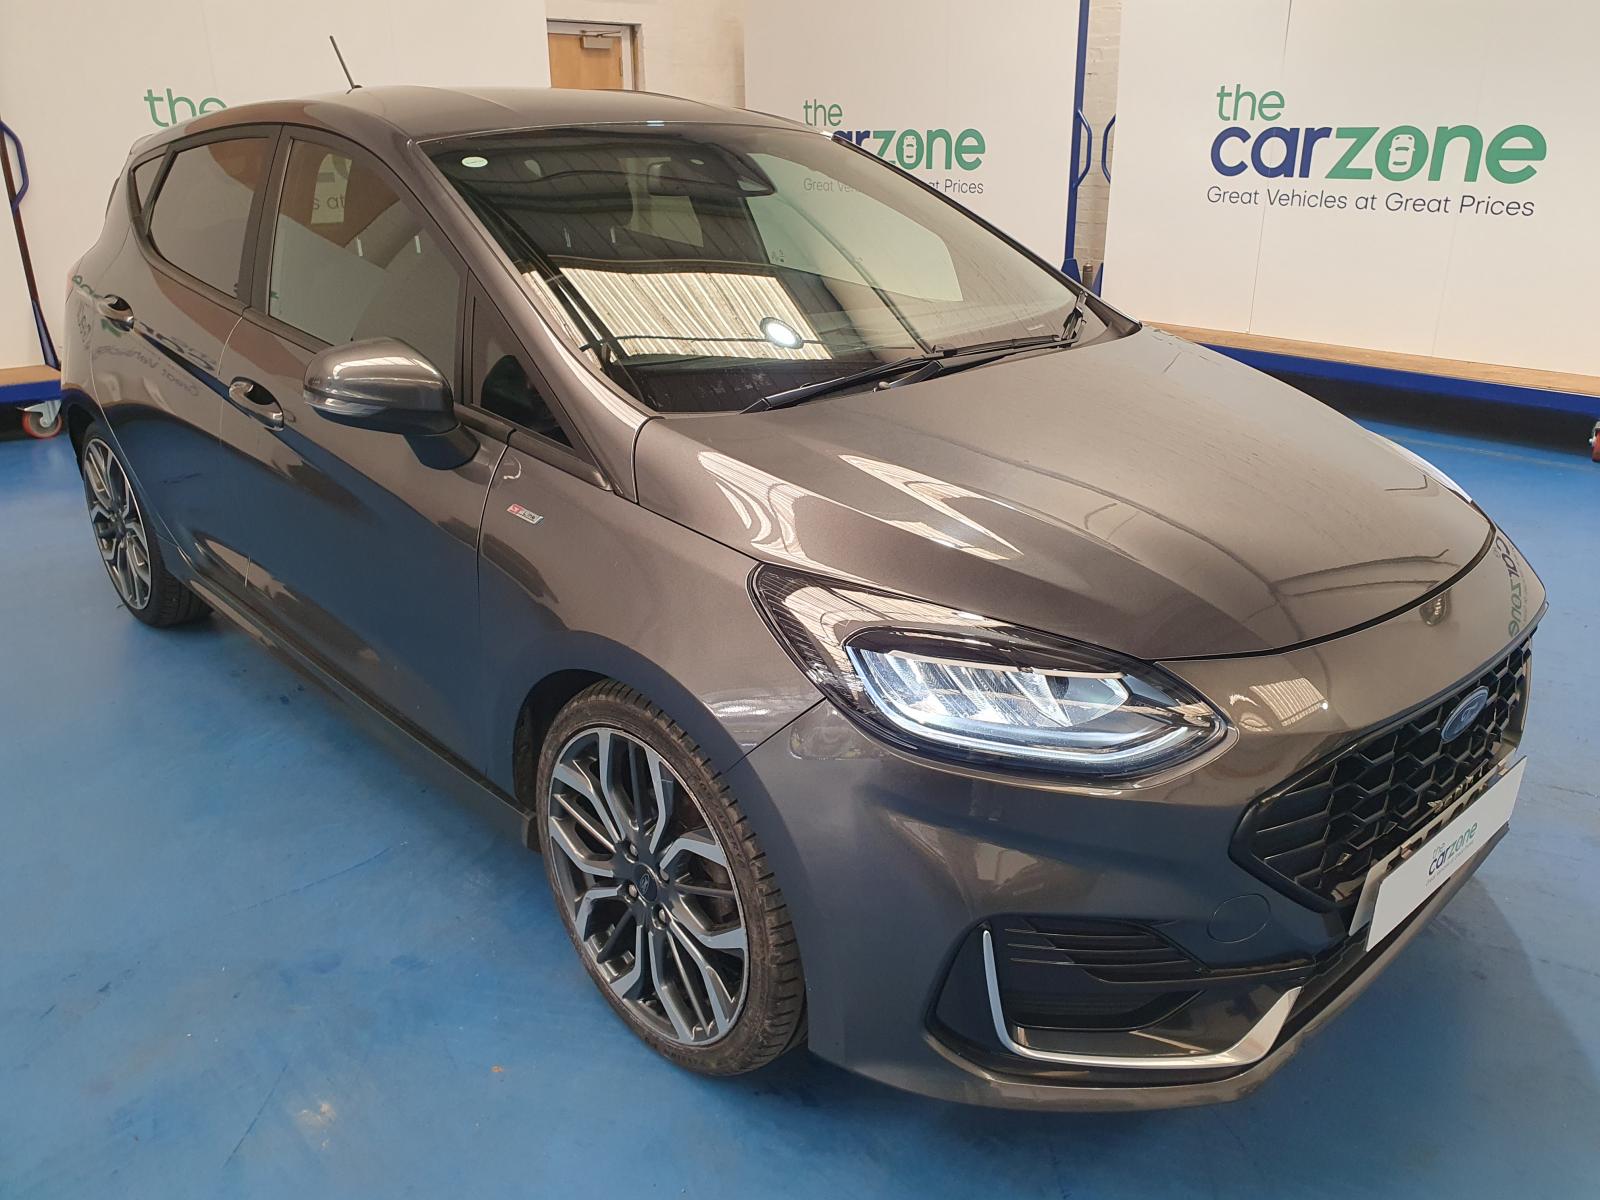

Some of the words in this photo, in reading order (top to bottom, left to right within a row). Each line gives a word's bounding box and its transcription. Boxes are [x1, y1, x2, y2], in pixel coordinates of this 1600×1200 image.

[803, 98, 843, 126] the
[1216, 83, 1285, 121] the
[831, 129, 986, 171] rzone
[1210, 124, 1547, 185] carzone
[803, 177, 833, 191] Great
[944, 178, 984, 194] Prices
[1206, 185, 1260, 206] Great
[1266, 188, 1348, 209] Vehicles
[1354, 195, 1377, 211] at
[1384, 192, 1451, 214] Great
[1458, 194, 1535, 217] Prices
[1428, 822, 1478, 876] carzone
